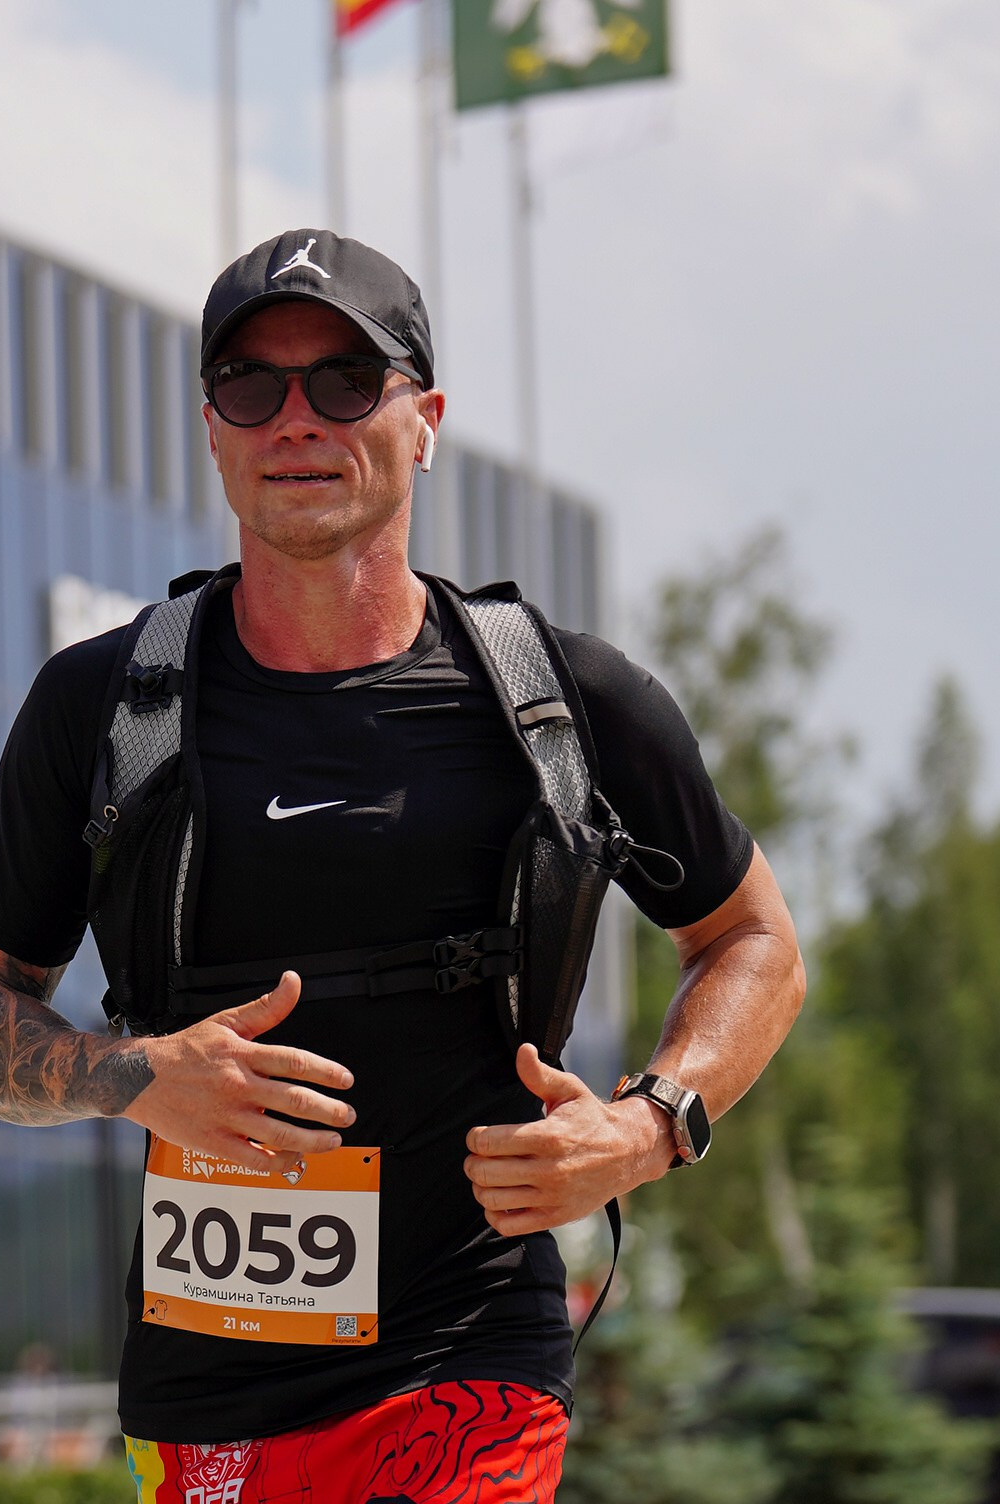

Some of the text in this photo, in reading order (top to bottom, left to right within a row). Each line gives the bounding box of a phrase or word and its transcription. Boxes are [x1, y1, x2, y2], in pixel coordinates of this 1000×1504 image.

[152, 1199, 357, 1288] 2059
[183, 1281, 315, 1307] Курамшина Татьяна
[223, 1316, 236, 1330] 21
